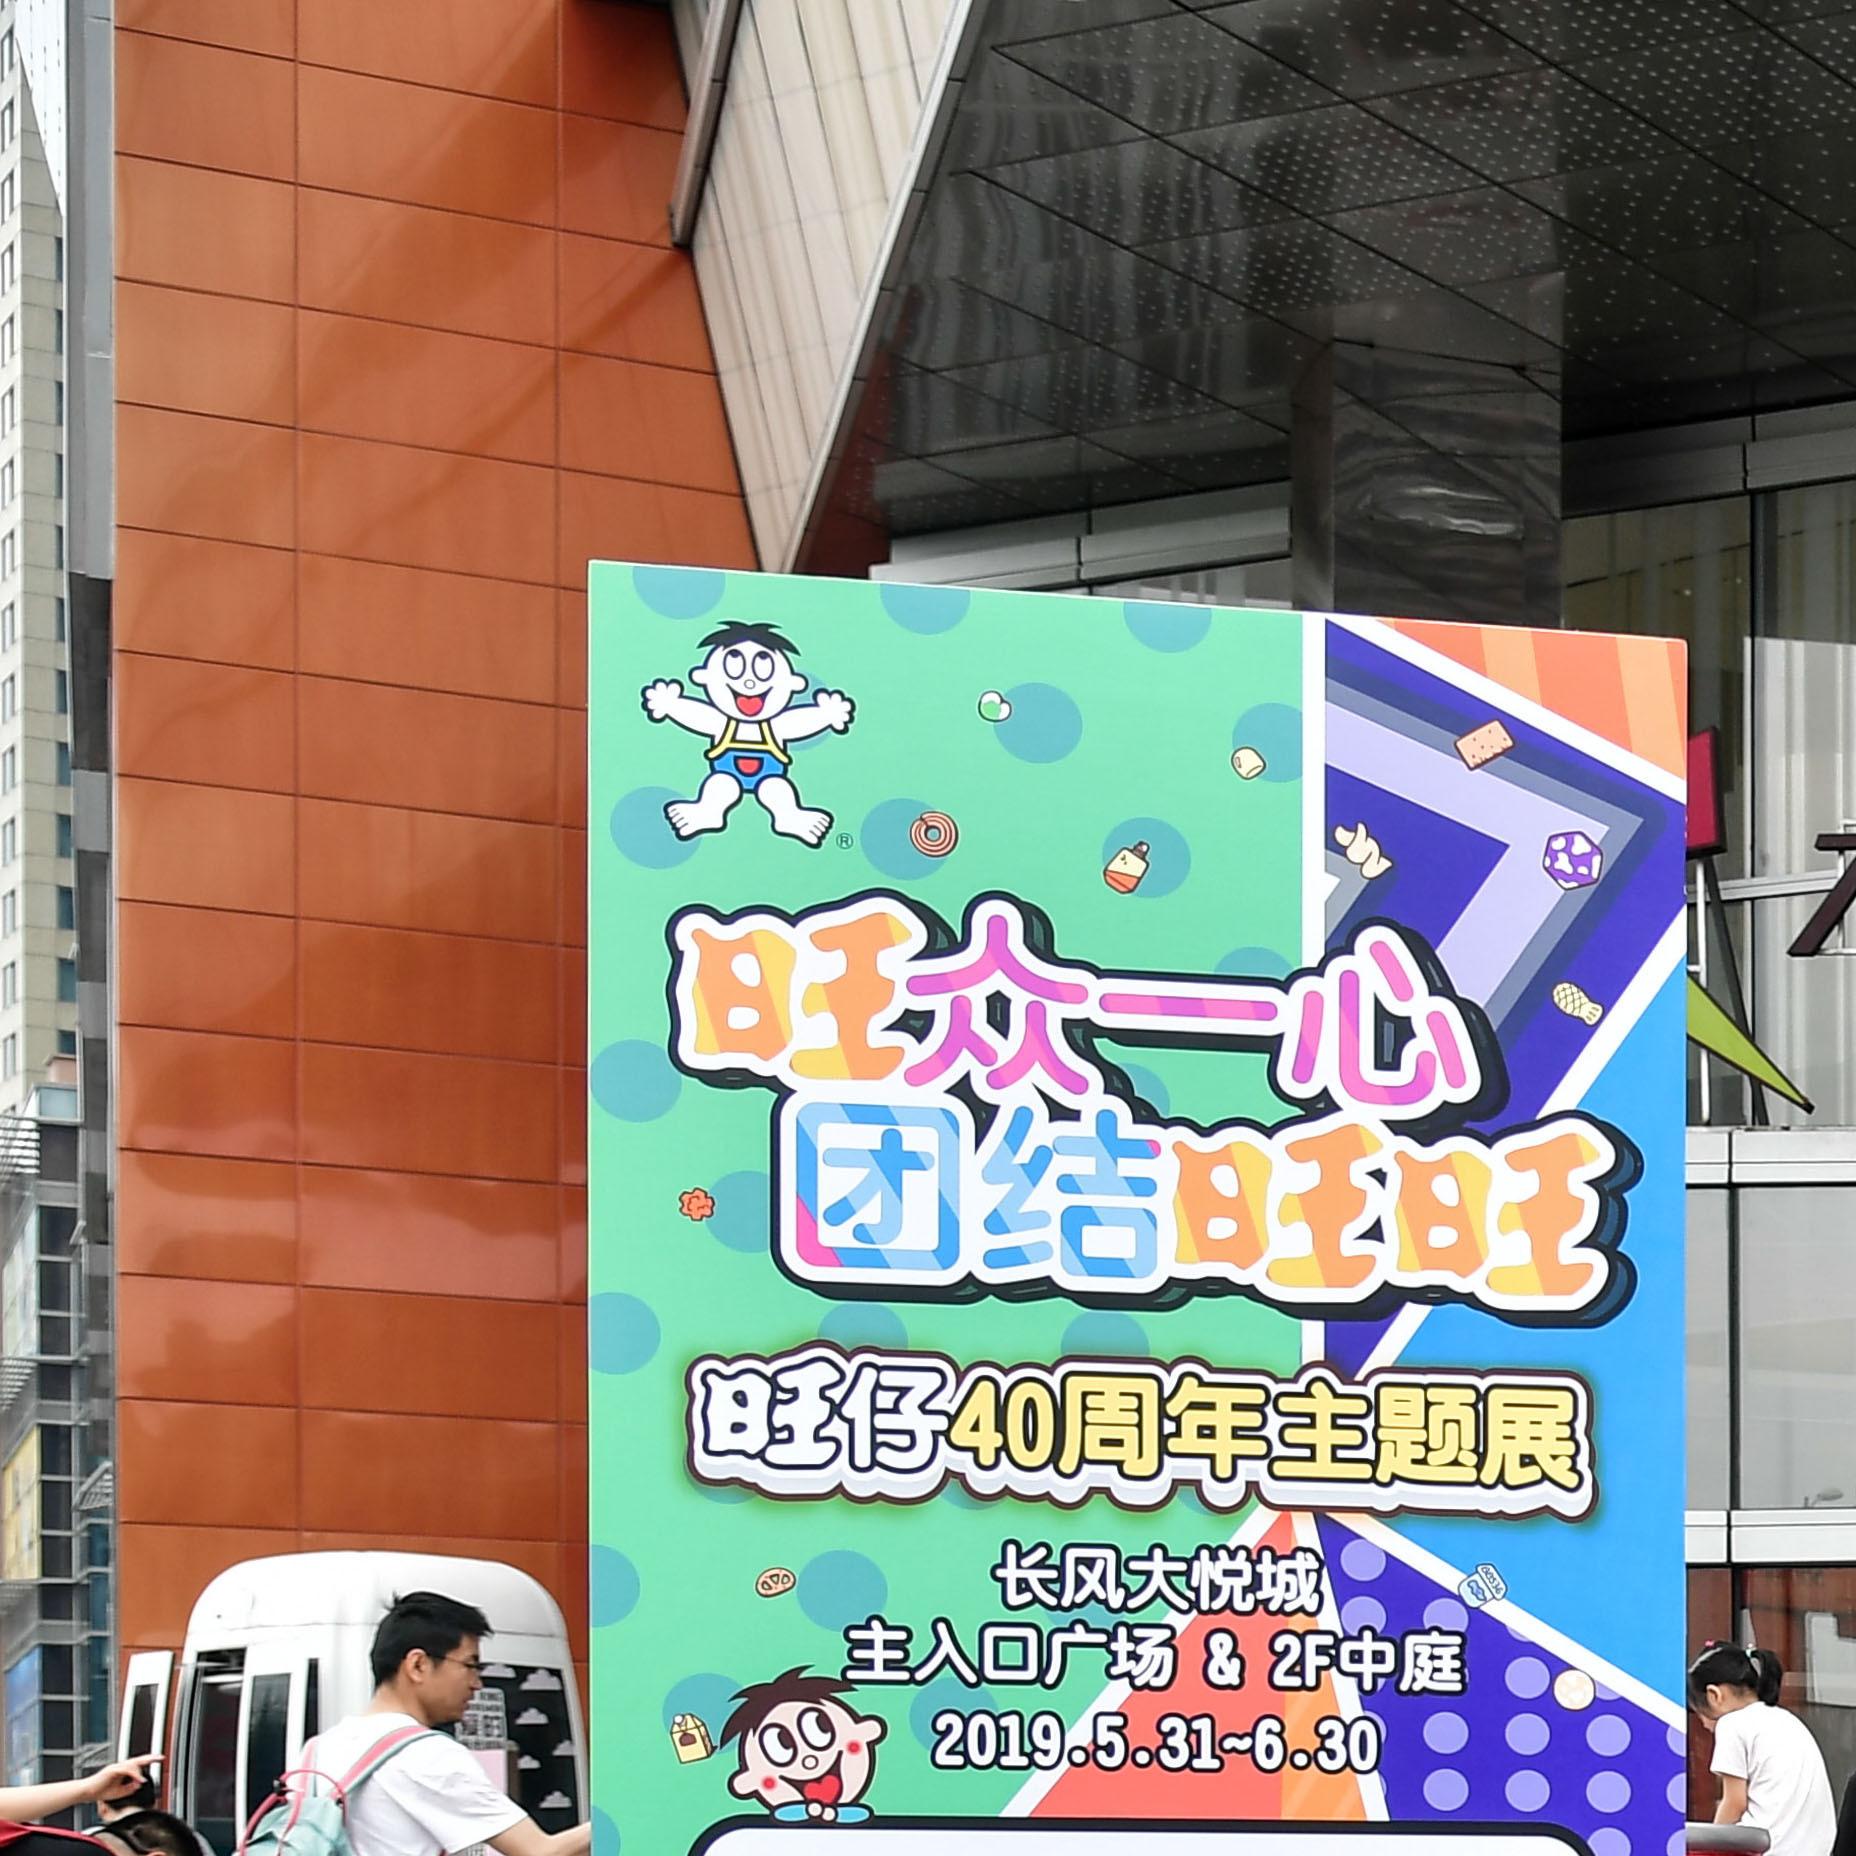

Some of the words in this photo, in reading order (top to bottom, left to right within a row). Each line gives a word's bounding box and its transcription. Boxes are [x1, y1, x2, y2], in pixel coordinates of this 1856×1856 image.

[687, 906, 1470, 1106] 旺众一心
[794, 1100, 1604, 1298] 团结旺旺
[698, 1362, 1581, 1490] 旺仔40周年主题展
[996, 1543, 1321, 1614] 长风大悦城
[846, 1624, 1174, 1692] 主入口广场
[1207, 1636, 1241, 1686] &
[1274, 1631, 1464, 1696] 2F中庭
[934, 1713, 1382, 1776] 2019.5.31~6.30
